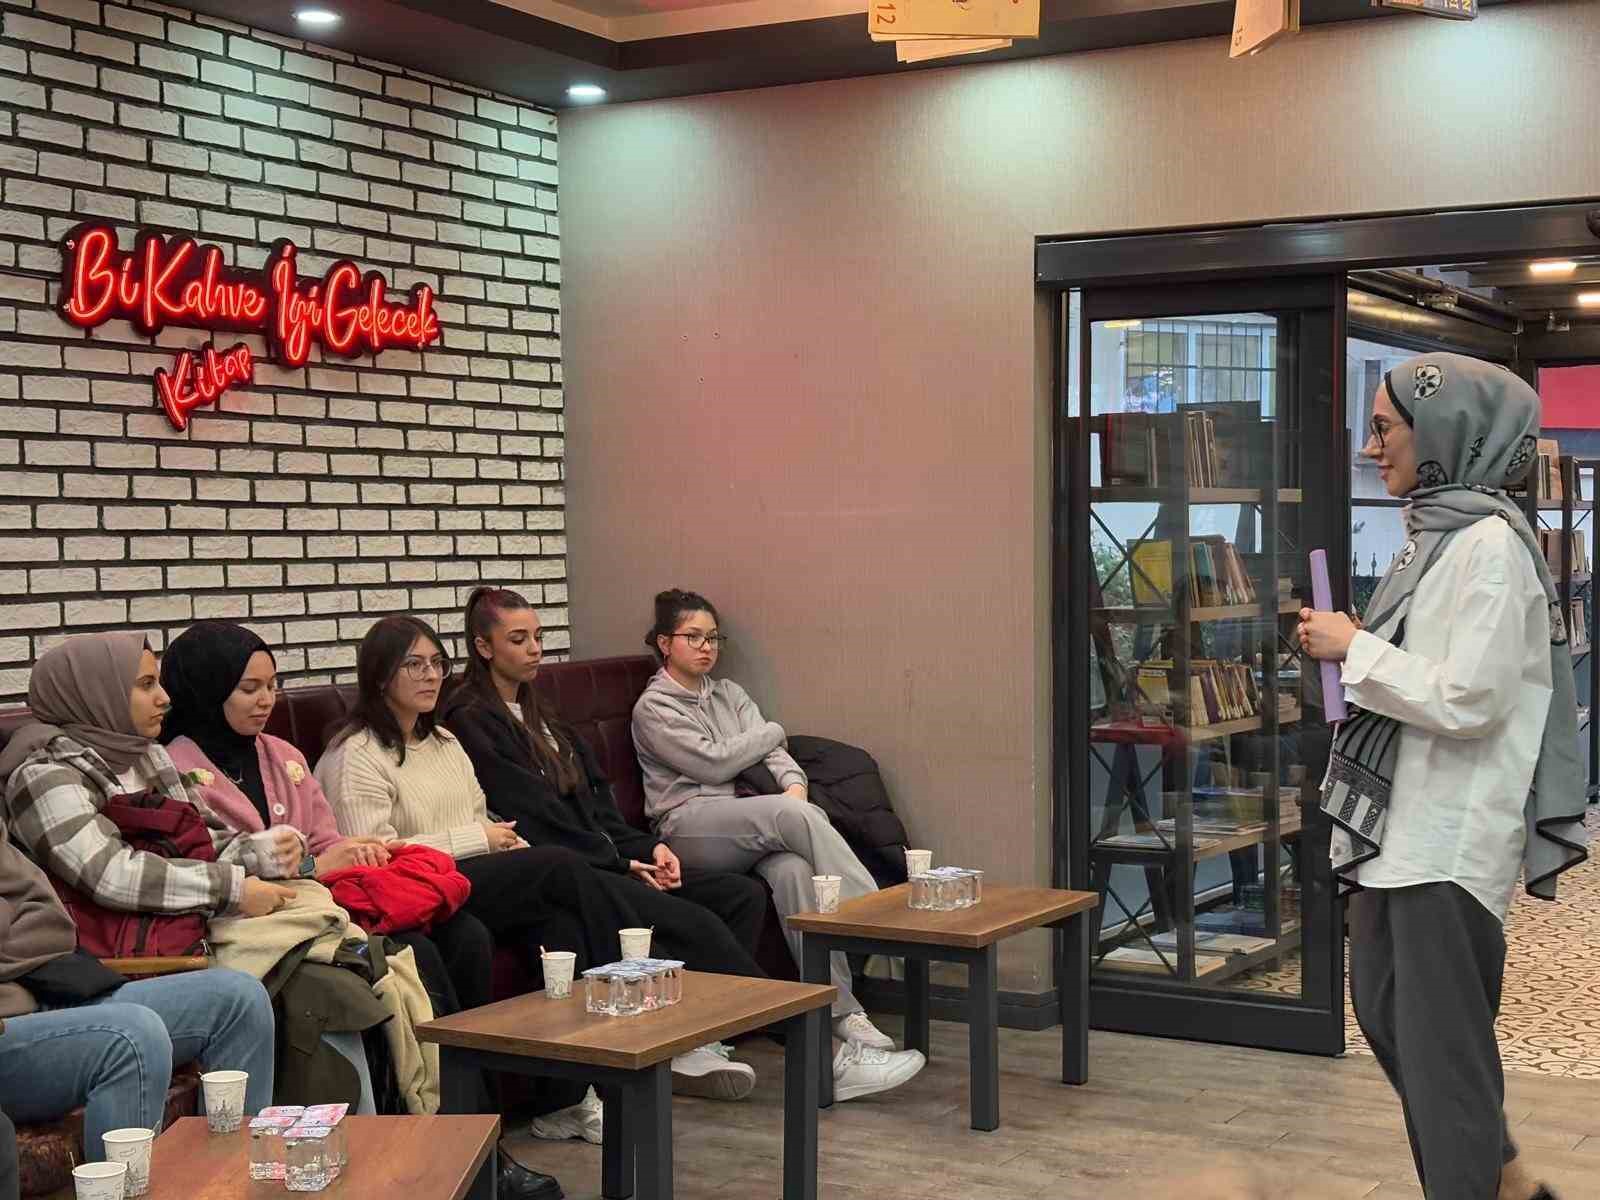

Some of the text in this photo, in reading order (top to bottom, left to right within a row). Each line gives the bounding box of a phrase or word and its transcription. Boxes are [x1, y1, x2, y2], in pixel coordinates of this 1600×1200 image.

[70, 230, 139, 318] Bi
[144, 238, 266, 327] Kahve
[325, 264, 438, 349] Gelecek
[159, 346, 251, 429] Kitap
